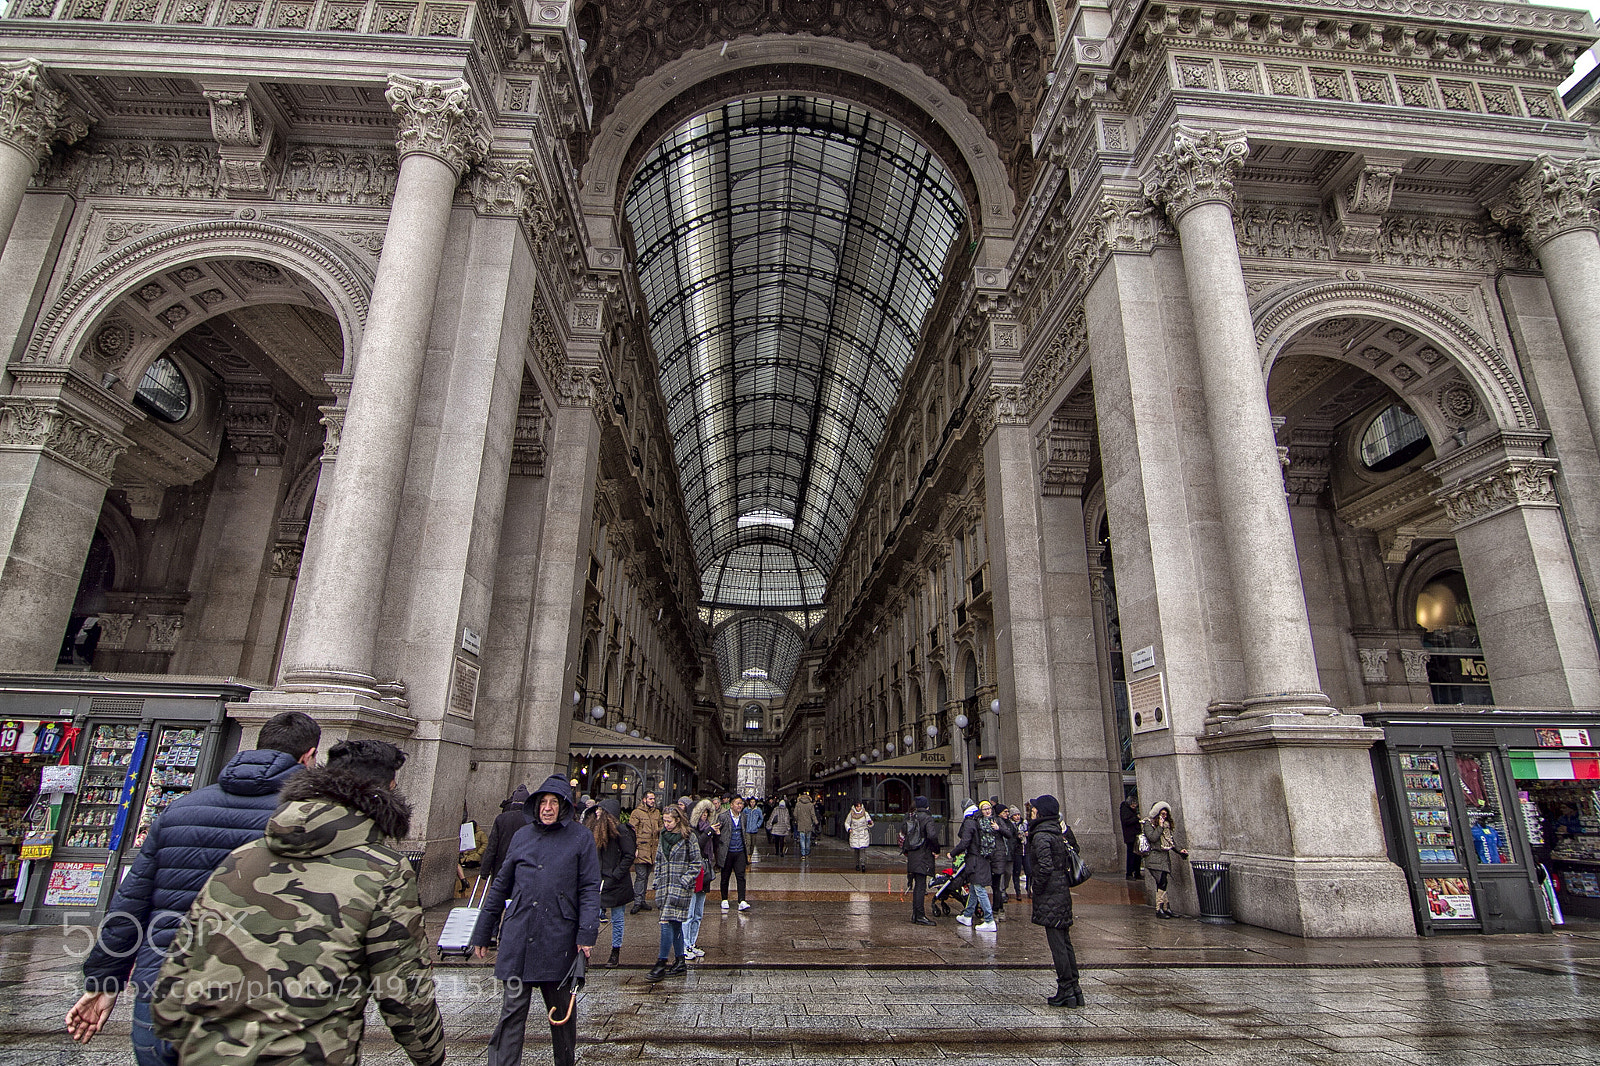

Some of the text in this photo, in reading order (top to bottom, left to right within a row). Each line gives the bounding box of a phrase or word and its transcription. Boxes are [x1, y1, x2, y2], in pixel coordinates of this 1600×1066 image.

[1, 729, 17, 747] 19
[43, 733, 55, 751] 9
[920, 752, 946, 762] Motta
